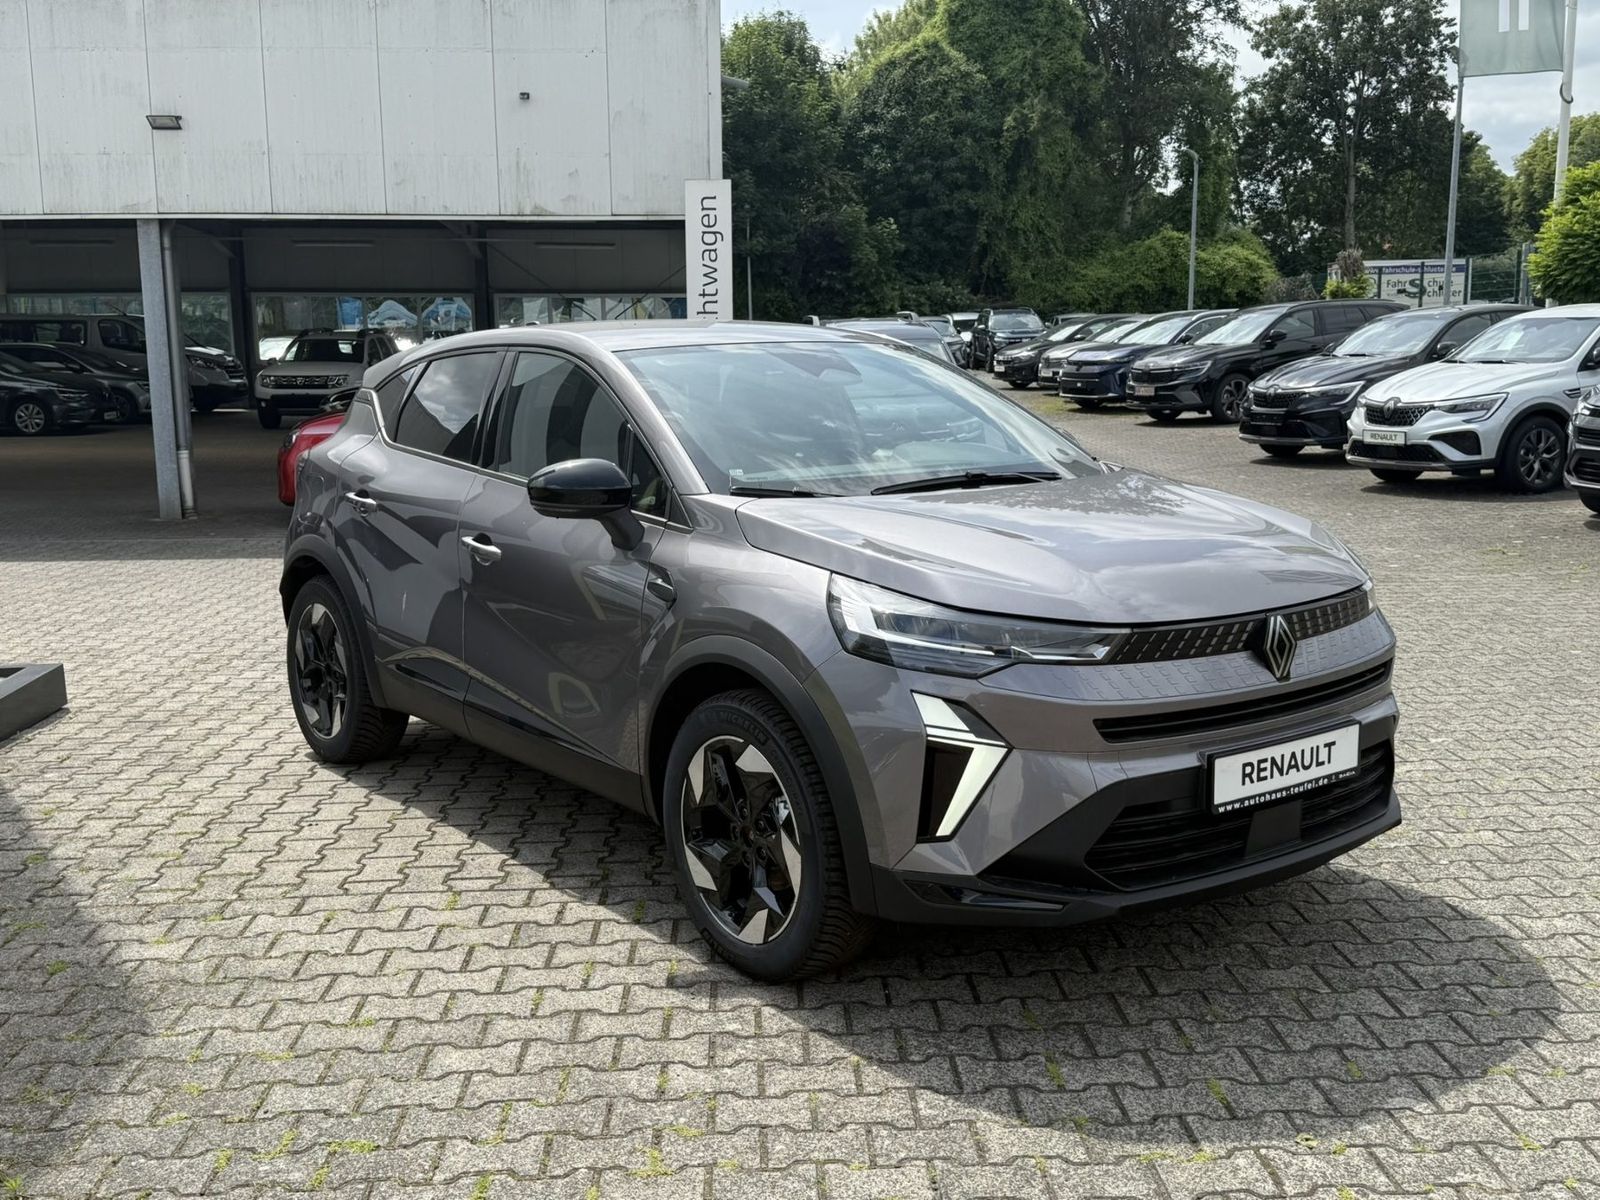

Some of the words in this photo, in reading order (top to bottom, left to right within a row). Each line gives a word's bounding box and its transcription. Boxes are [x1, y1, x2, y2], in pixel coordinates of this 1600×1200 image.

[696, 195, 723, 319] htwagen
[1370, 433, 1398, 441] RENAULT
[1241, 740, 1336, 786] RENAULT
[1218, 777, 1328, 813] www.autohaus-teufel.de
